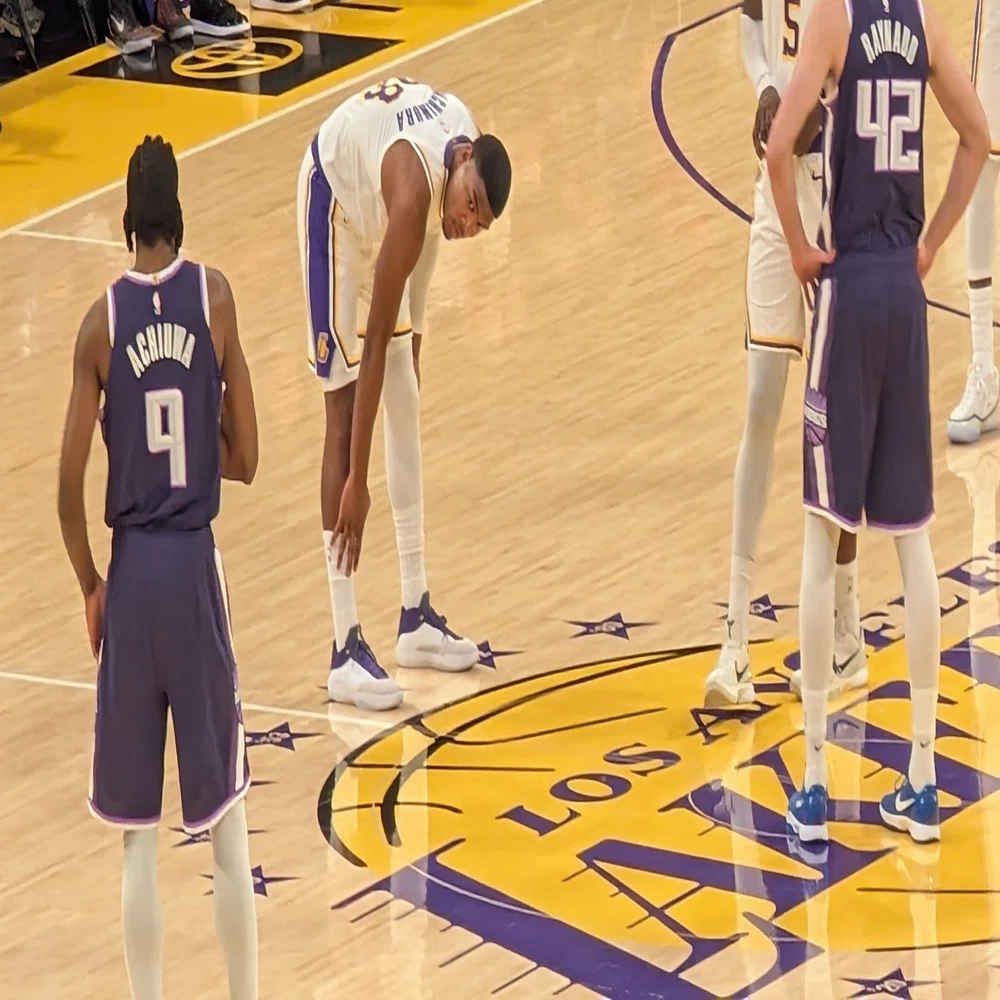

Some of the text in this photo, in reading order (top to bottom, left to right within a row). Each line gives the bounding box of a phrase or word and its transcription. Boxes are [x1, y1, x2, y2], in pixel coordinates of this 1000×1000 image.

[855, 78, 923, 173] 42
[125, 322, 196, 379] ACHIUWA
[144, 388, 188, 489] 9
[495, 742, 682, 837] LOS
